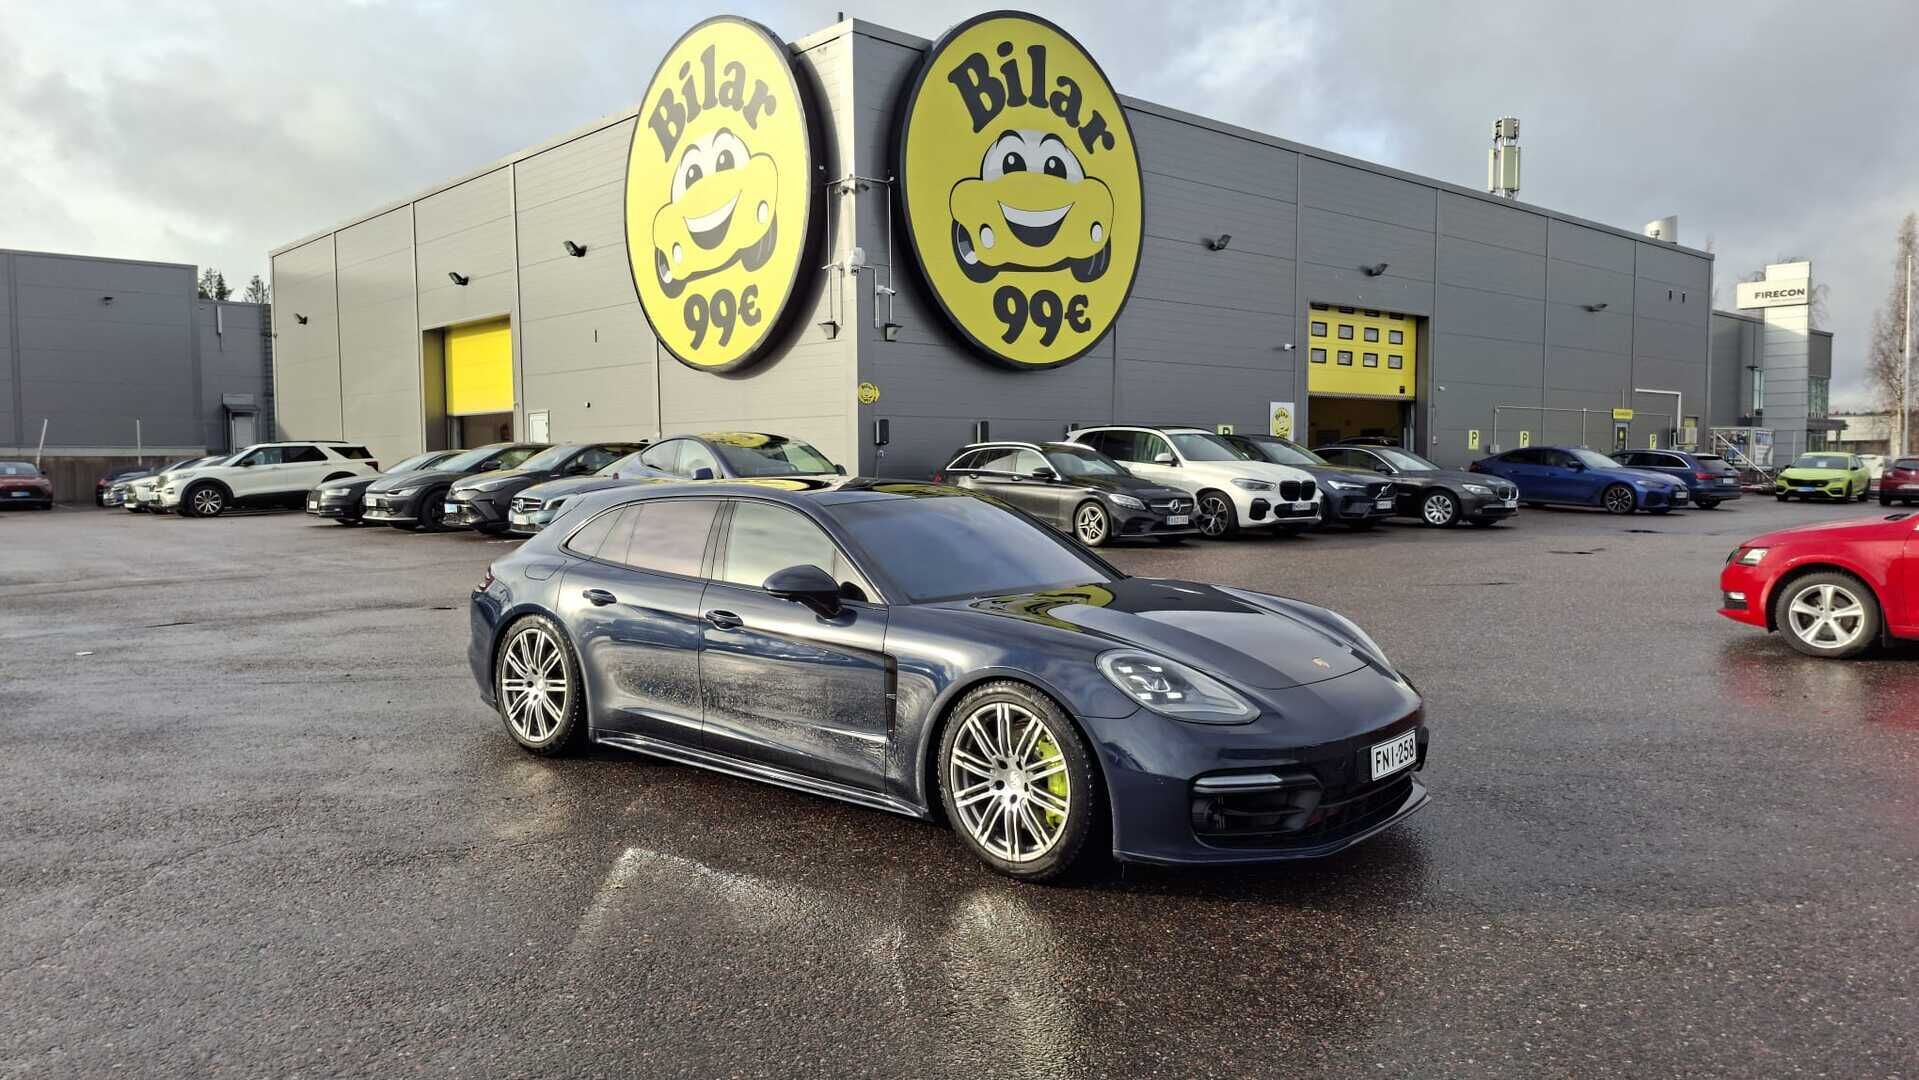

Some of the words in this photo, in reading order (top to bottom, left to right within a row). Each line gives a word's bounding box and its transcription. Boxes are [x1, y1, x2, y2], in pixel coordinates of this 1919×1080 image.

[648, 44, 776, 162] Bilar
[948, 41, 1115, 154] Bilar
[684, 284, 762, 350] 99€
[993, 285, 1091, 347] 99€
[1754, 288, 1805, 299] FIRECON
[1471, 431, 1478, 446] P
[1522, 432, 1528, 446] P
[1375, 738, 1414, 773] FNI-258
